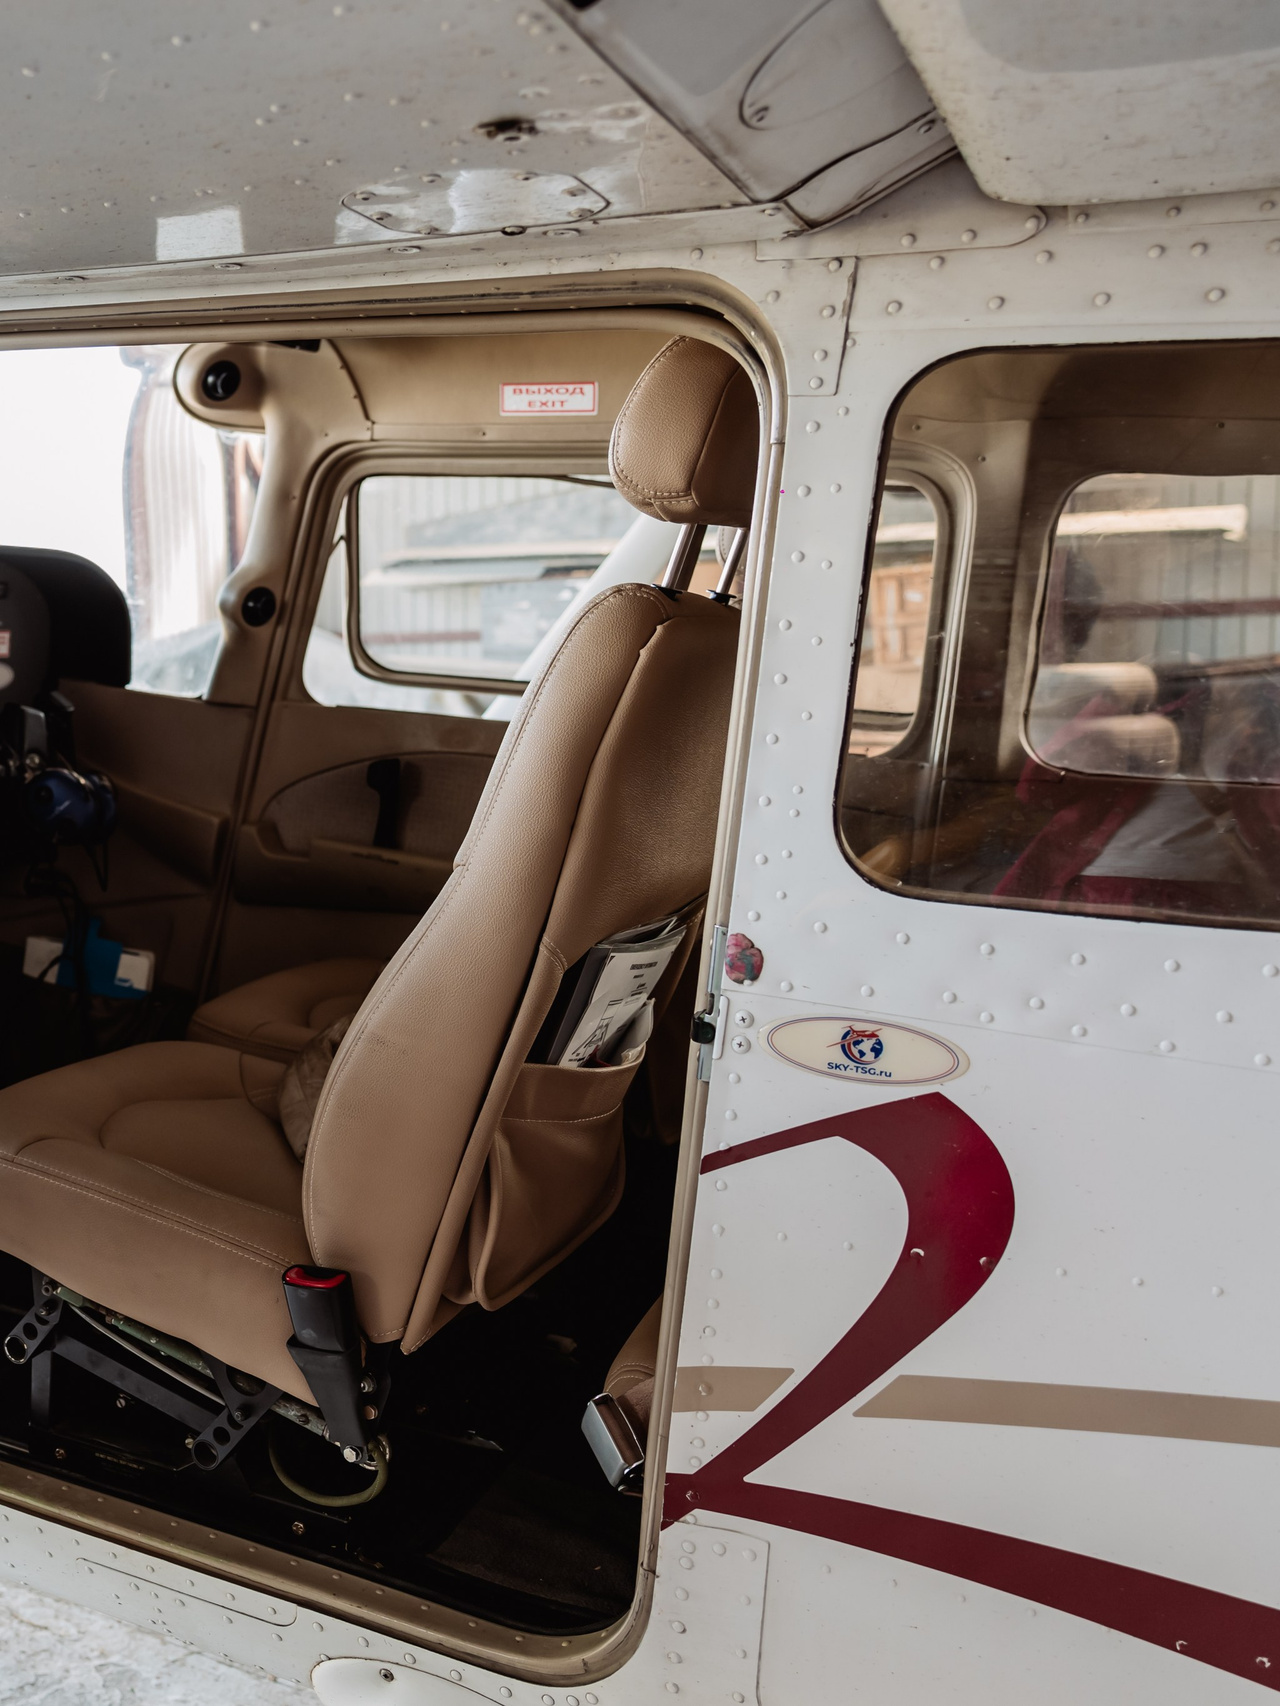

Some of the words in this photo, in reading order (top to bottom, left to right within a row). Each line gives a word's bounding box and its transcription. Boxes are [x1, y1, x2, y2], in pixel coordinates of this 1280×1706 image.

[513, 386, 585, 396] ВЫХОД
[528, 400, 568, 408] EXIT
[826, 1061, 892, 1078] SKY-TSG.ru
